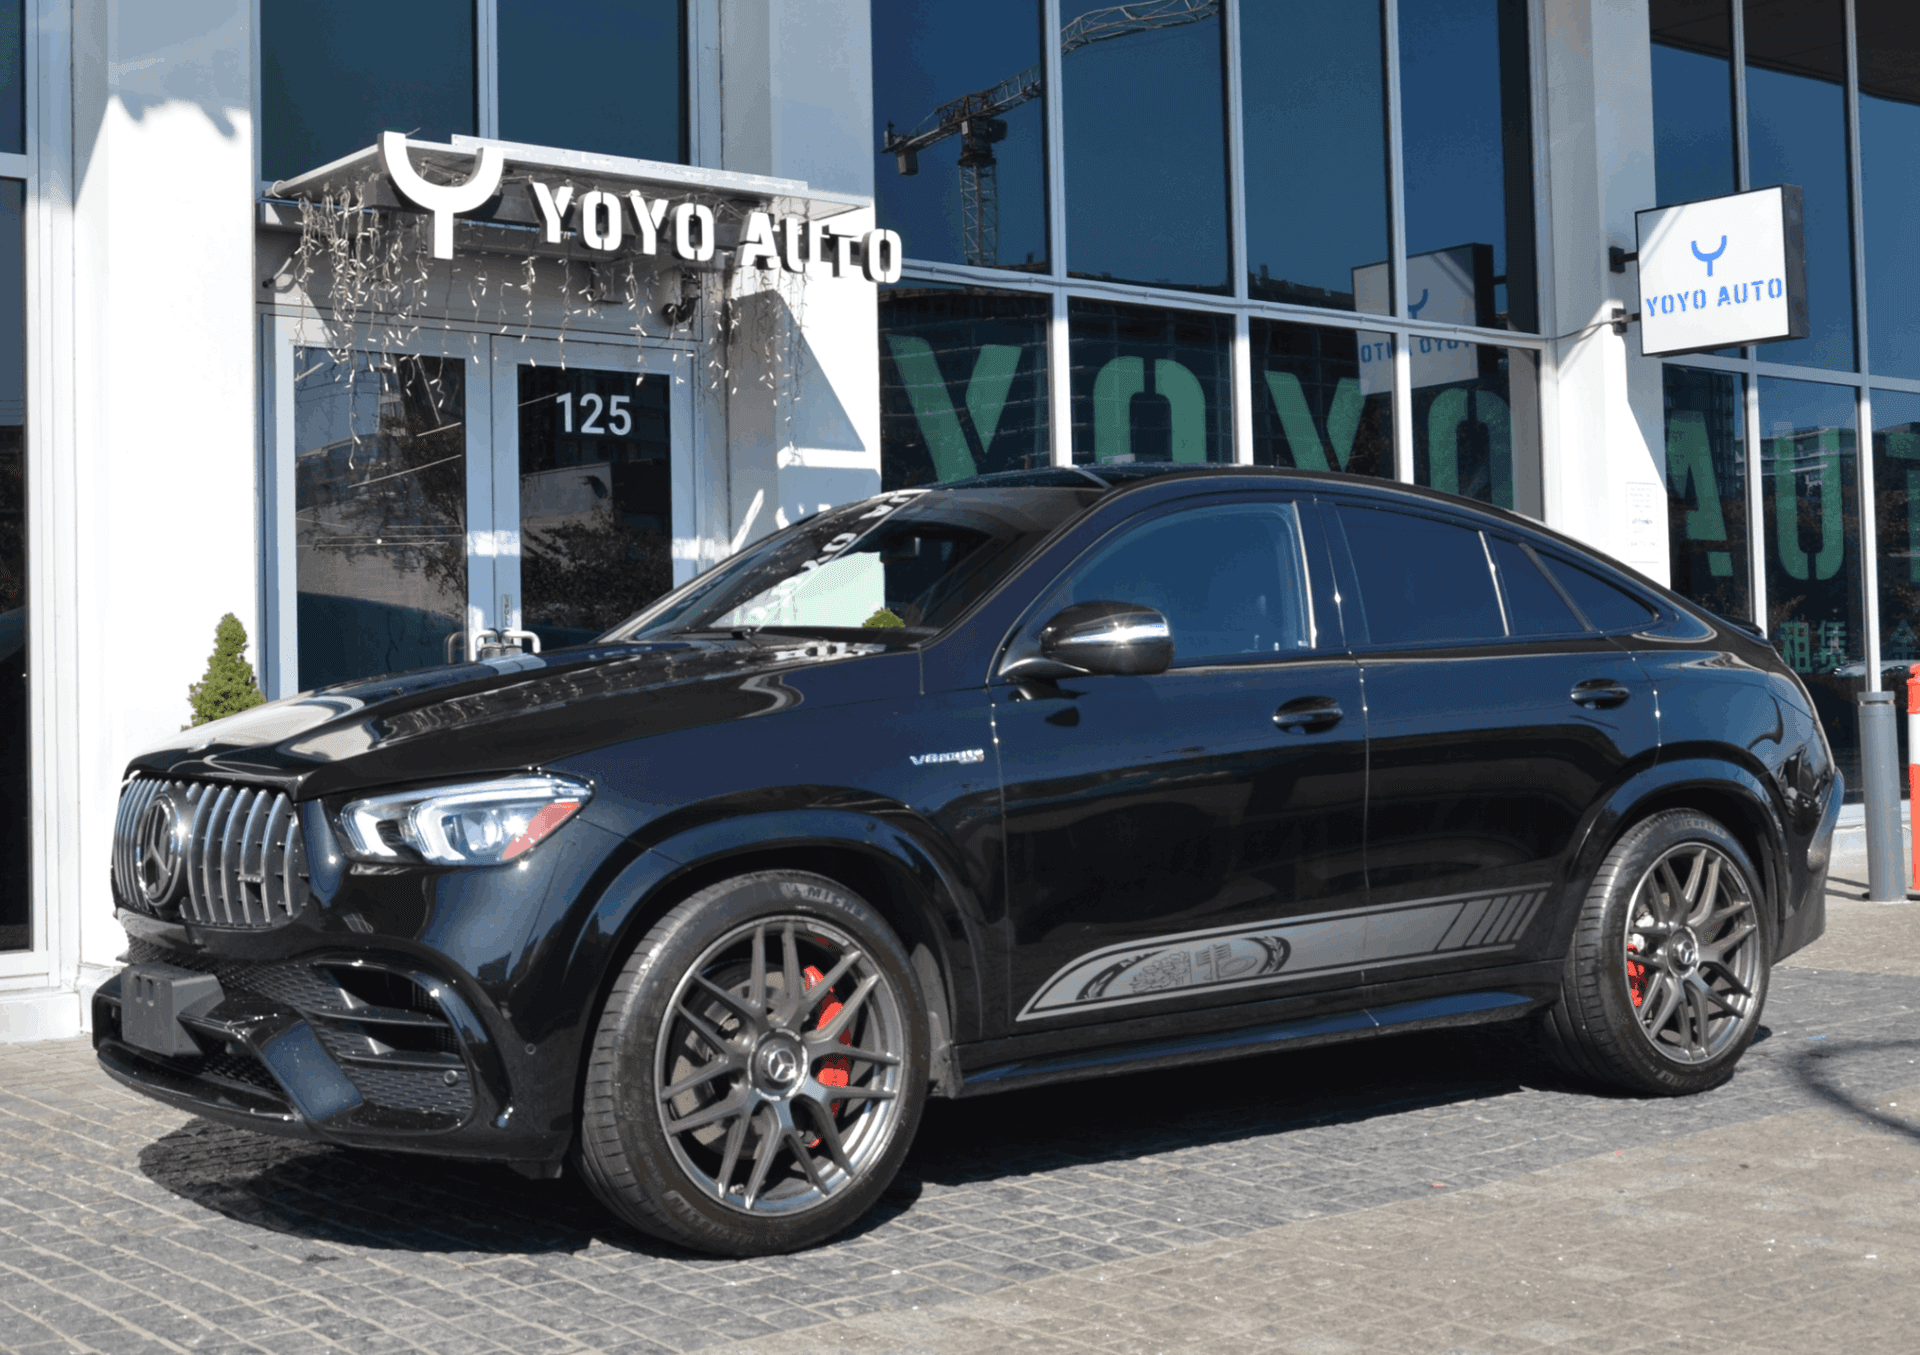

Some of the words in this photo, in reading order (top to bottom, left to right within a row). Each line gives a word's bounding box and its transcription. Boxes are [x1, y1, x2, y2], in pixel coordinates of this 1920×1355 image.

[528, 181, 715, 262] YOYO
[735, 211, 902, 284] AUTO
[1646, 289, 1707, 317] YOYO
[1717, 278, 1782, 307] AUTO
[556, 391, 632, 436] 125
